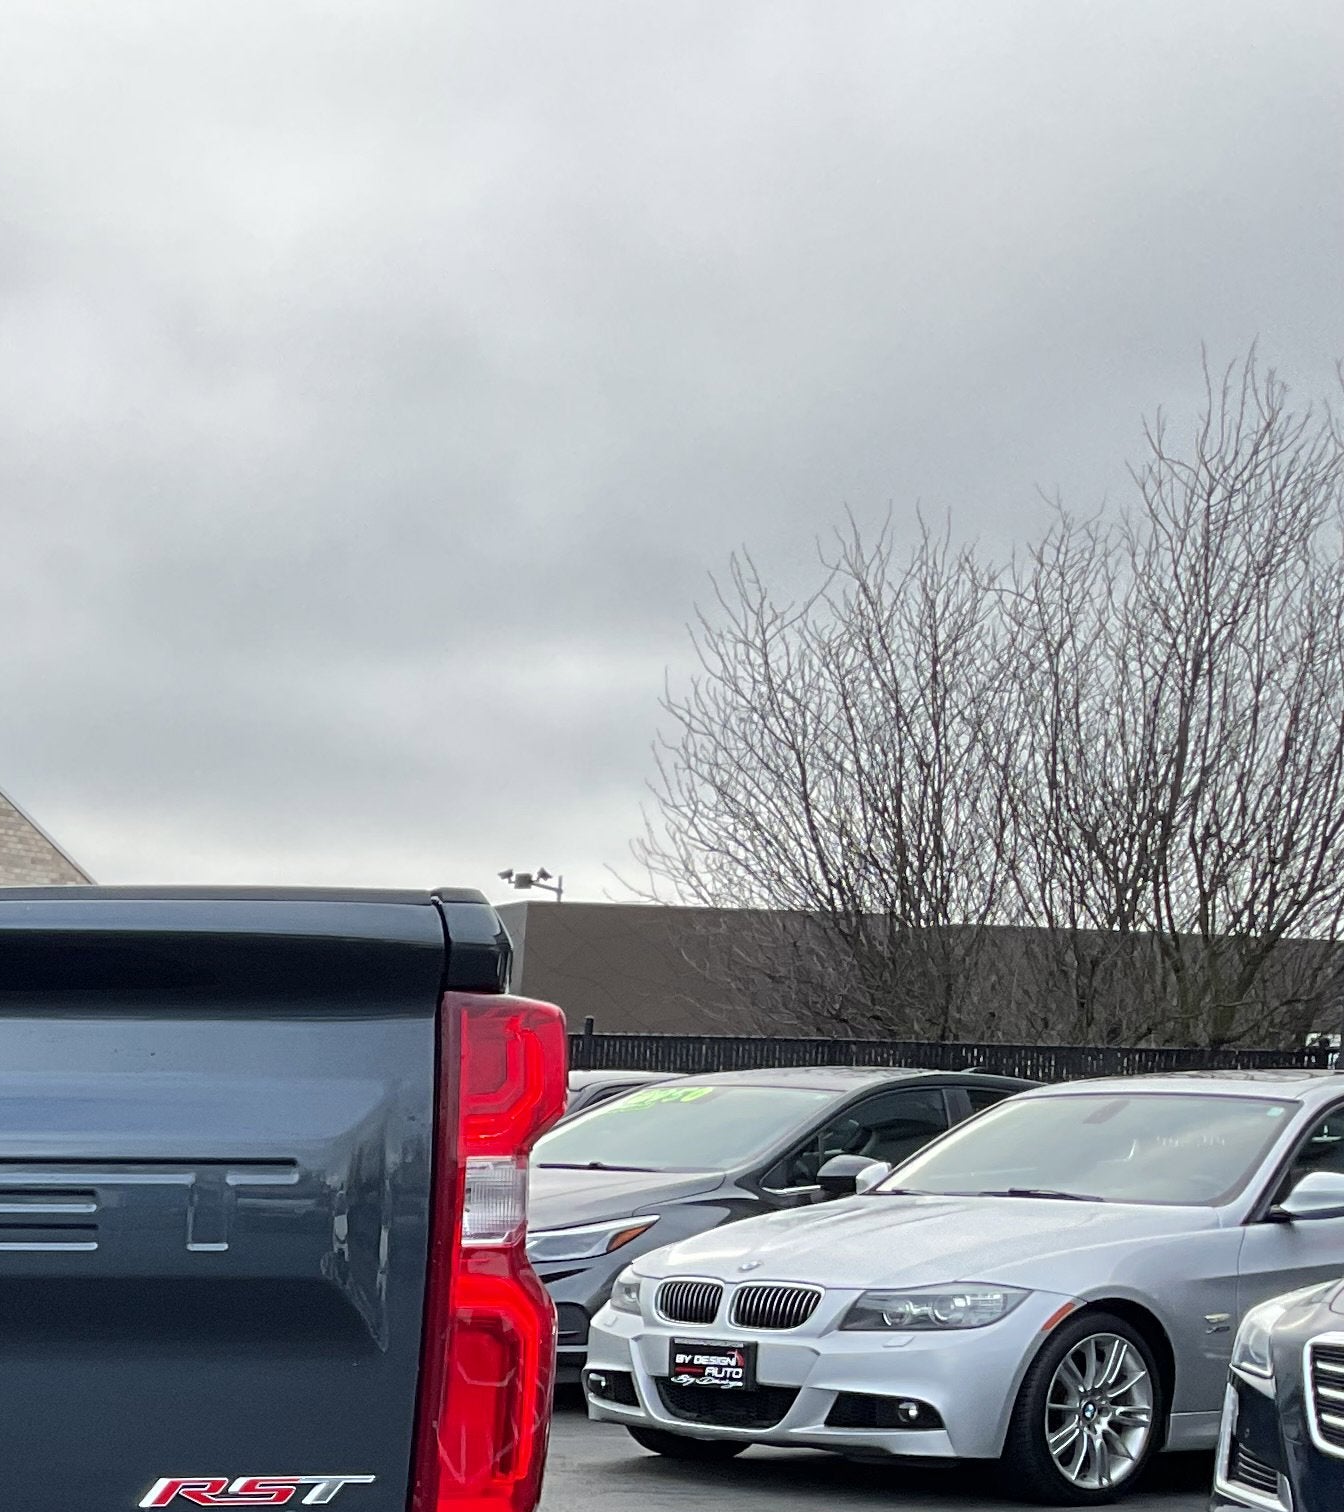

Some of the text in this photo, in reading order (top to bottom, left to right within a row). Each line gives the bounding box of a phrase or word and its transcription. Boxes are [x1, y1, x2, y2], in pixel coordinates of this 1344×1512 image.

[675, 1353, 737, 1367] BY DESIGN
[704, 1366, 743, 1379] AUTO
[138, 1475, 376, 1508] RST
